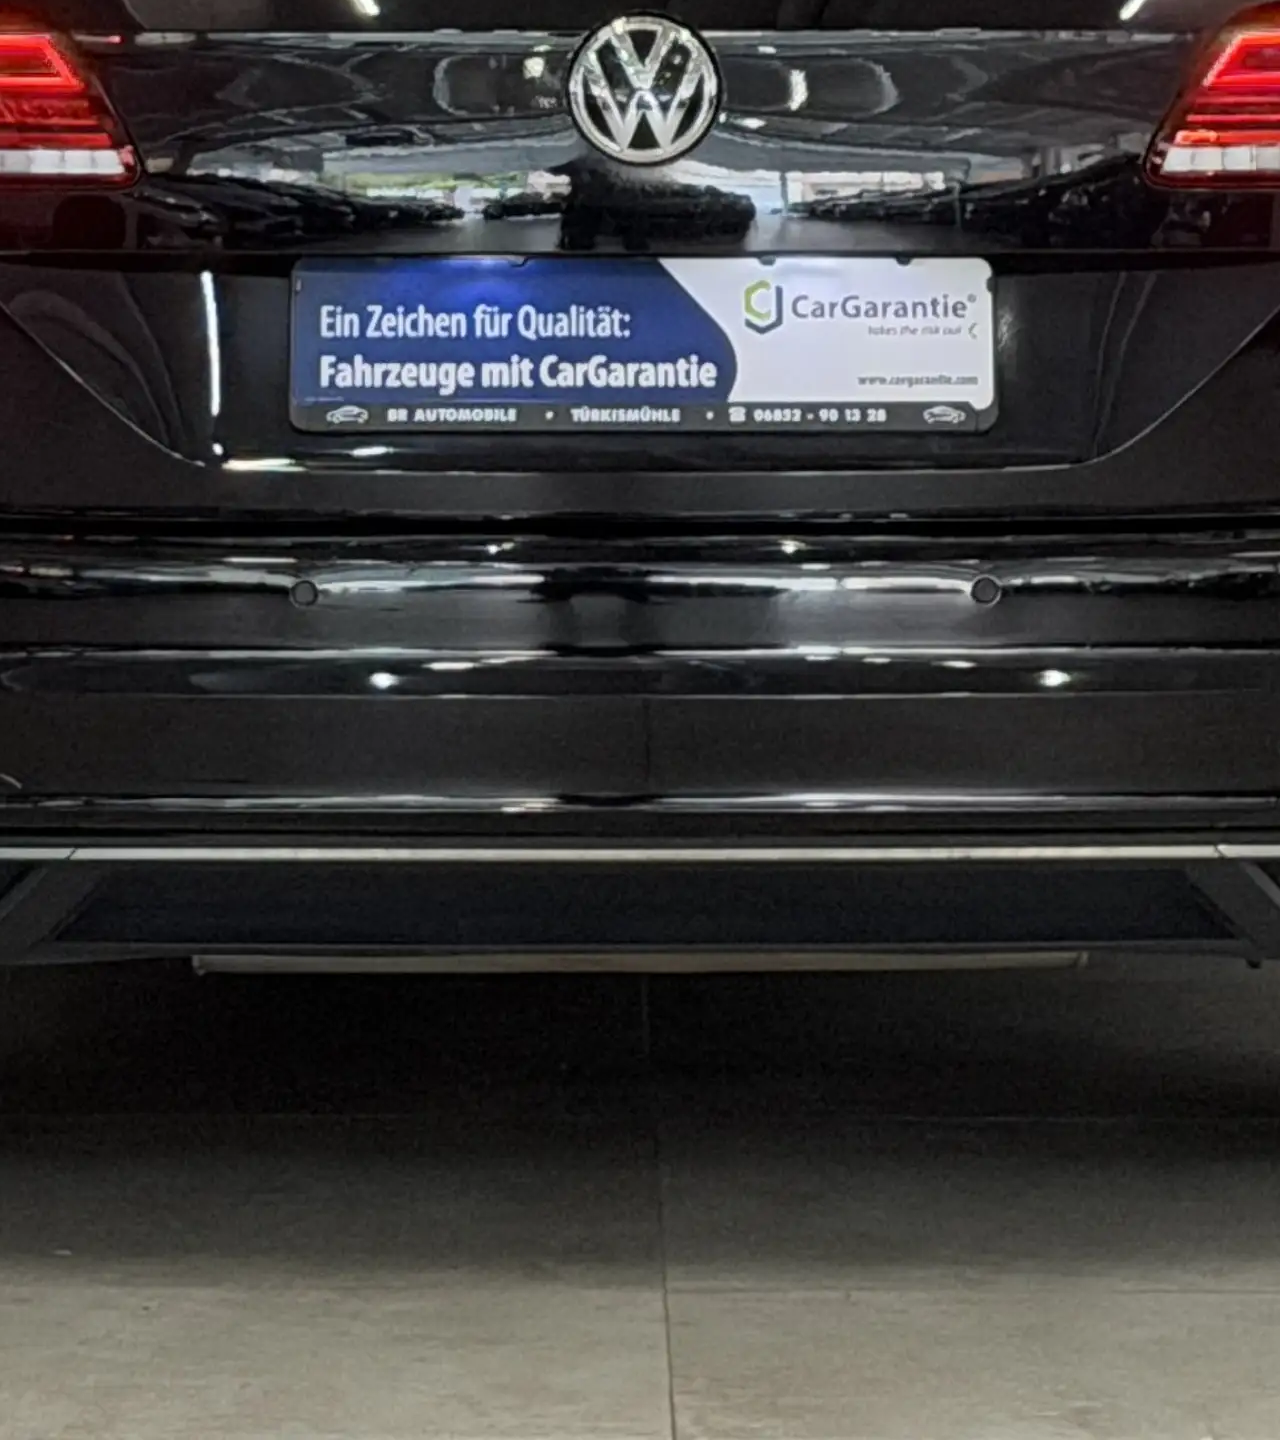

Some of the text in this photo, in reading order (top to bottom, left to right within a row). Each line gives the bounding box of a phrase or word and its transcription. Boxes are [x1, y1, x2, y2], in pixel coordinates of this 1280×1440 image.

[320, 304, 631, 340] Ein Zeichen für Qualität:
[320, 354, 717, 395] Fahrzeuge mit CarGarantie
[857, 374, 979, 388] www.cargarantie.com
[414, 408, 517, 422] AUTOMOBILE
[570, 406, 681, 422] TÜRKISMÜHLE
